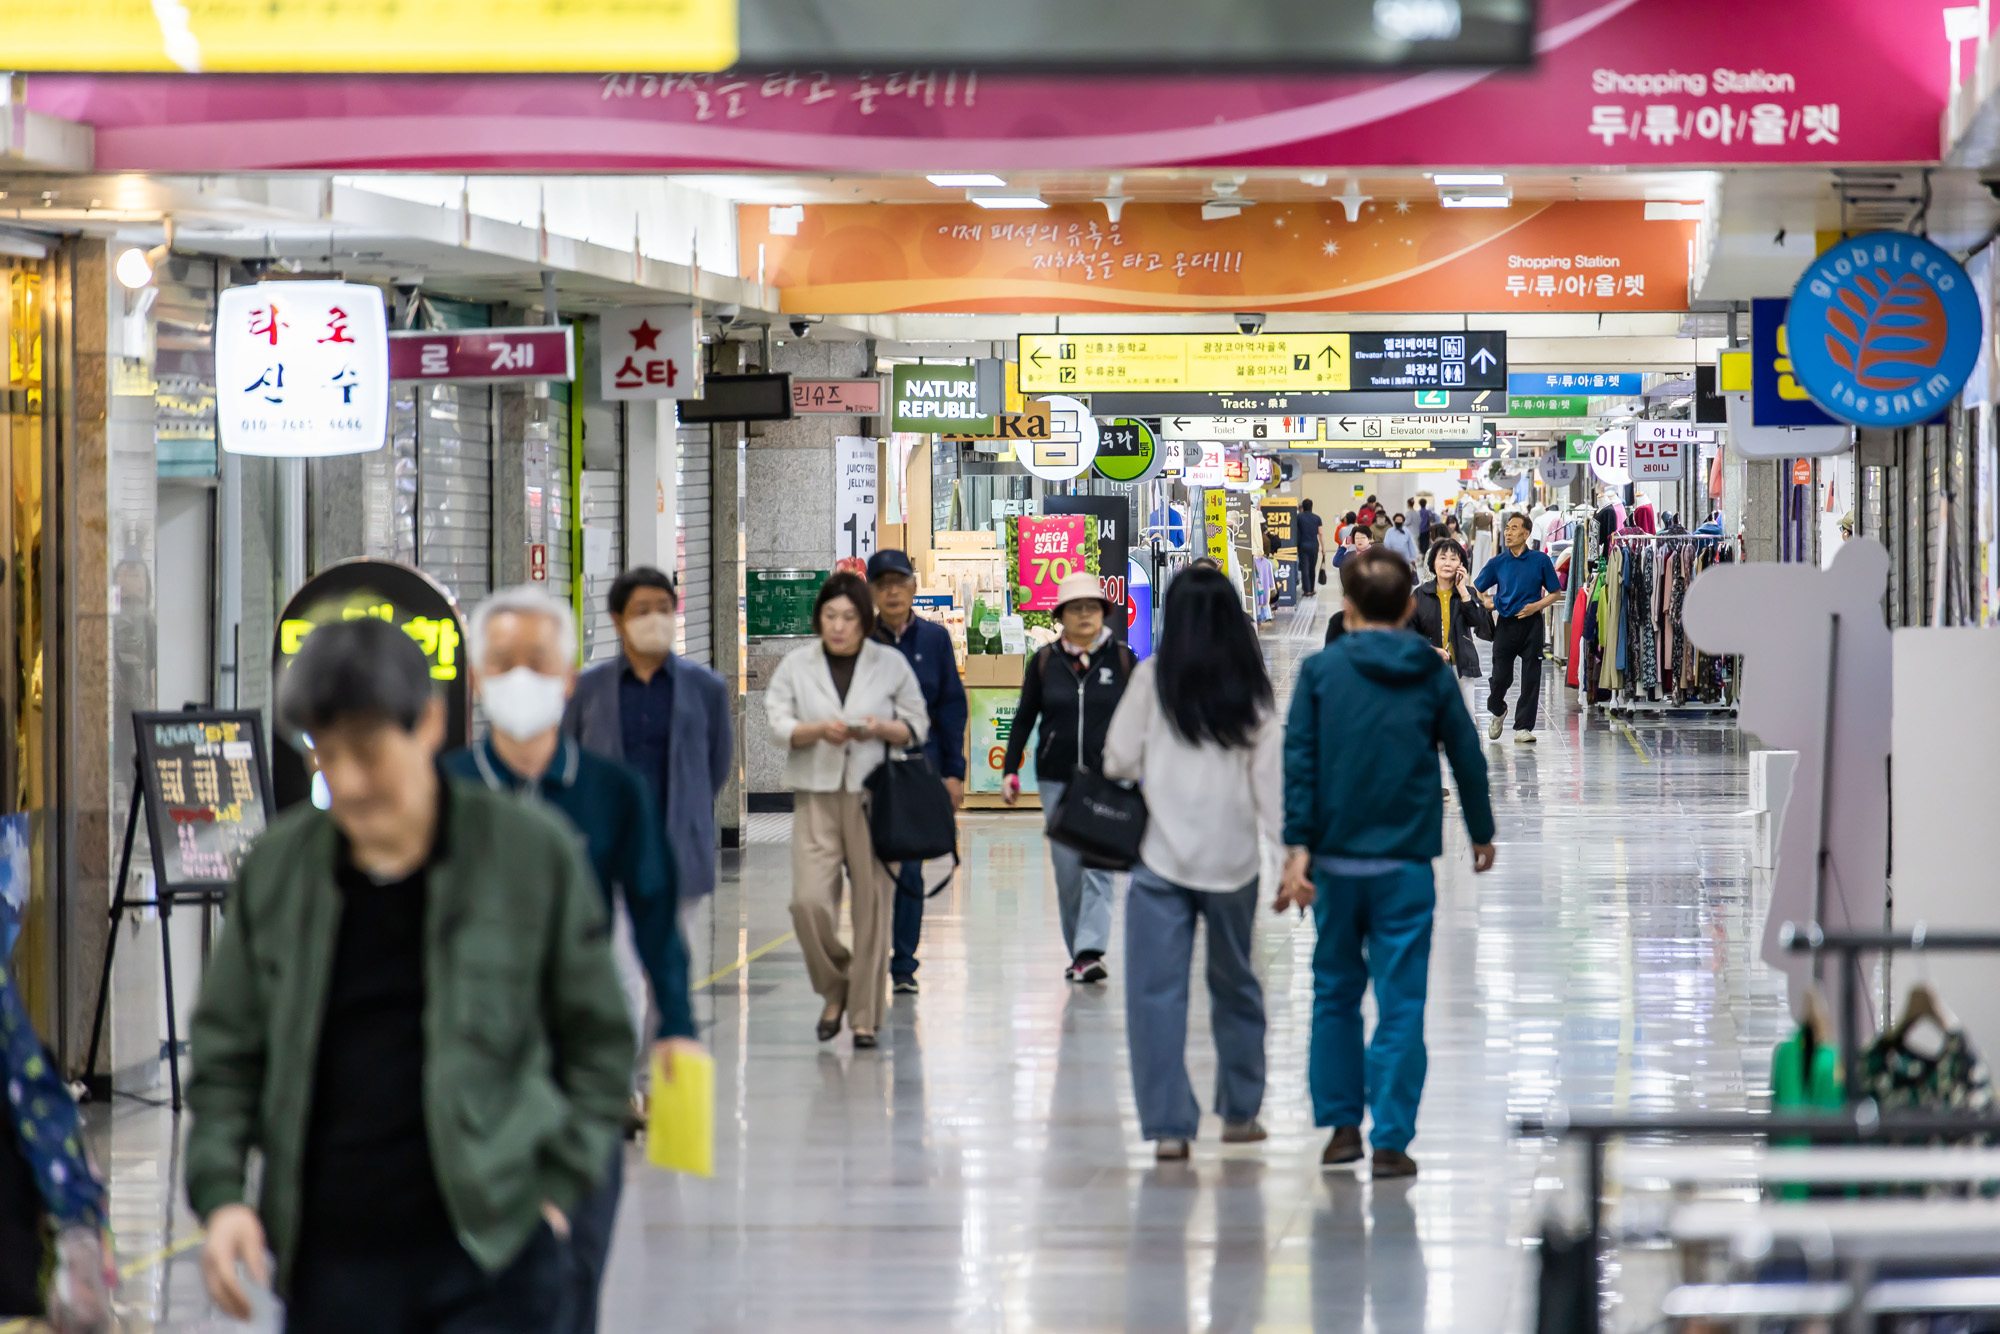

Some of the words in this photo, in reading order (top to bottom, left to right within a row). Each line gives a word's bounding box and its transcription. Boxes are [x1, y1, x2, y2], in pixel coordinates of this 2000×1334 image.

[1592, 68, 1707, 97] Shopping
[1712, 68, 1795, 94] Station
[1588, 103, 1839, 146] 두/류/아/울/렛
[938, 224, 981, 241] 이제
[991, 222, 1057, 247] 패션의
[1064, 220, 1123, 250] 유혹은
[1033, 250, 1115, 281] 지하철을
[1122, 252, 1164, 271] 타고
[1172, 250, 1242, 277] 온다!!!
[1508, 254, 1571, 270] Shopping
[1575, 254, 1620, 268] Station
[1810, 242, 1900, 298] global
[1910, 251, 1955, 292] eco
[1505, 274, 1645, 298] 두/류/아/울/렛
[1384, 338, 1437, 351] 엘리베이터
[1060, 344, 1075, 360] 11
[1355, 351, 1382, 359] Elevator
[1296, 355, 1308, 370] 7
[615, 355, 678, 389] 스타
[1060, 367, 1075, 383] 12
[1084, 366, 1126, 377] 두류공원
[1405, 364, 1437, 376] 화장실
[1371, 377, 1390, 385] Toilet
[1546, 375, 1620, 387] 두/류/아/울/렛
[899, 400, 988, 419] REPUBLI
[1221, 398, 1257, 409] Tracks
[1471, 404, 1489, 412] 15m
[1213, 426, 1235, 434] Toilet
[1391, 426, 1425, 435] Elevator
[846, 464, 864, 476] JUICY
[1547, 469, 1570, 480] 타로
[1643, 464, 1670, 473] 레이나
[848, 479, 864, 490] JELLY
[1267, 512, 1291, 526] 전자
[937, 535, 969, 544] BEAUTY
[1035, 531, 1069, 543] MEGA
[1034, 542, 1068, 554] SALE
